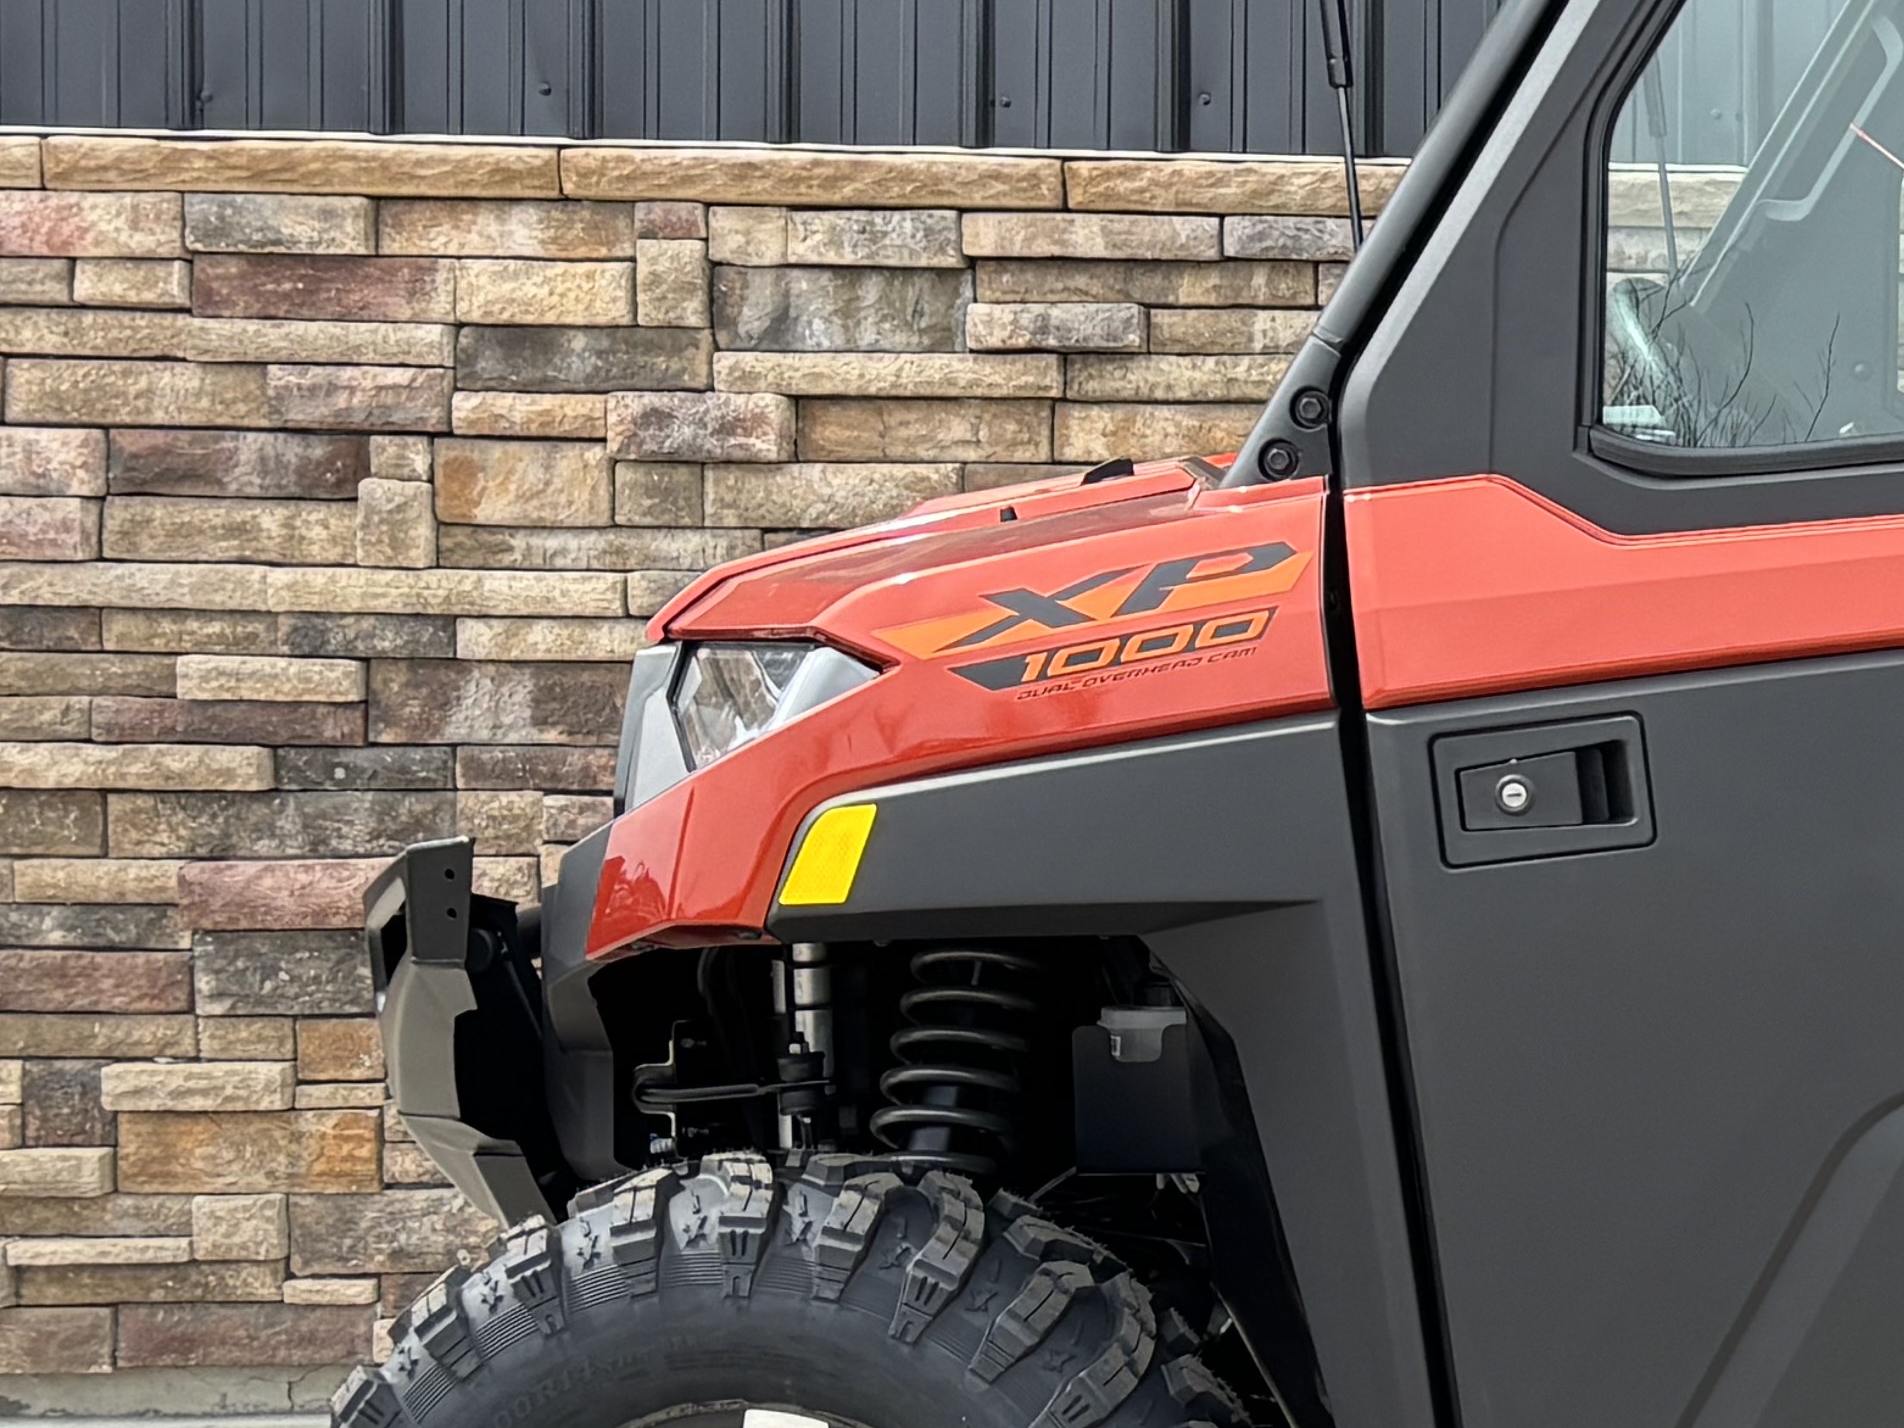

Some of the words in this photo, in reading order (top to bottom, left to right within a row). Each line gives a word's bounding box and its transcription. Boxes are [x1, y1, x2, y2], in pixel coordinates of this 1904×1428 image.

[933, 541, 1297, 652] XP
[1017, 679, 1079, 700] DUAL
[1082, 658, 1201, 688] OVERHEAD
[1207, 647, 1257, 664] CAM
[1021, 610, 1269, 683] 1000
